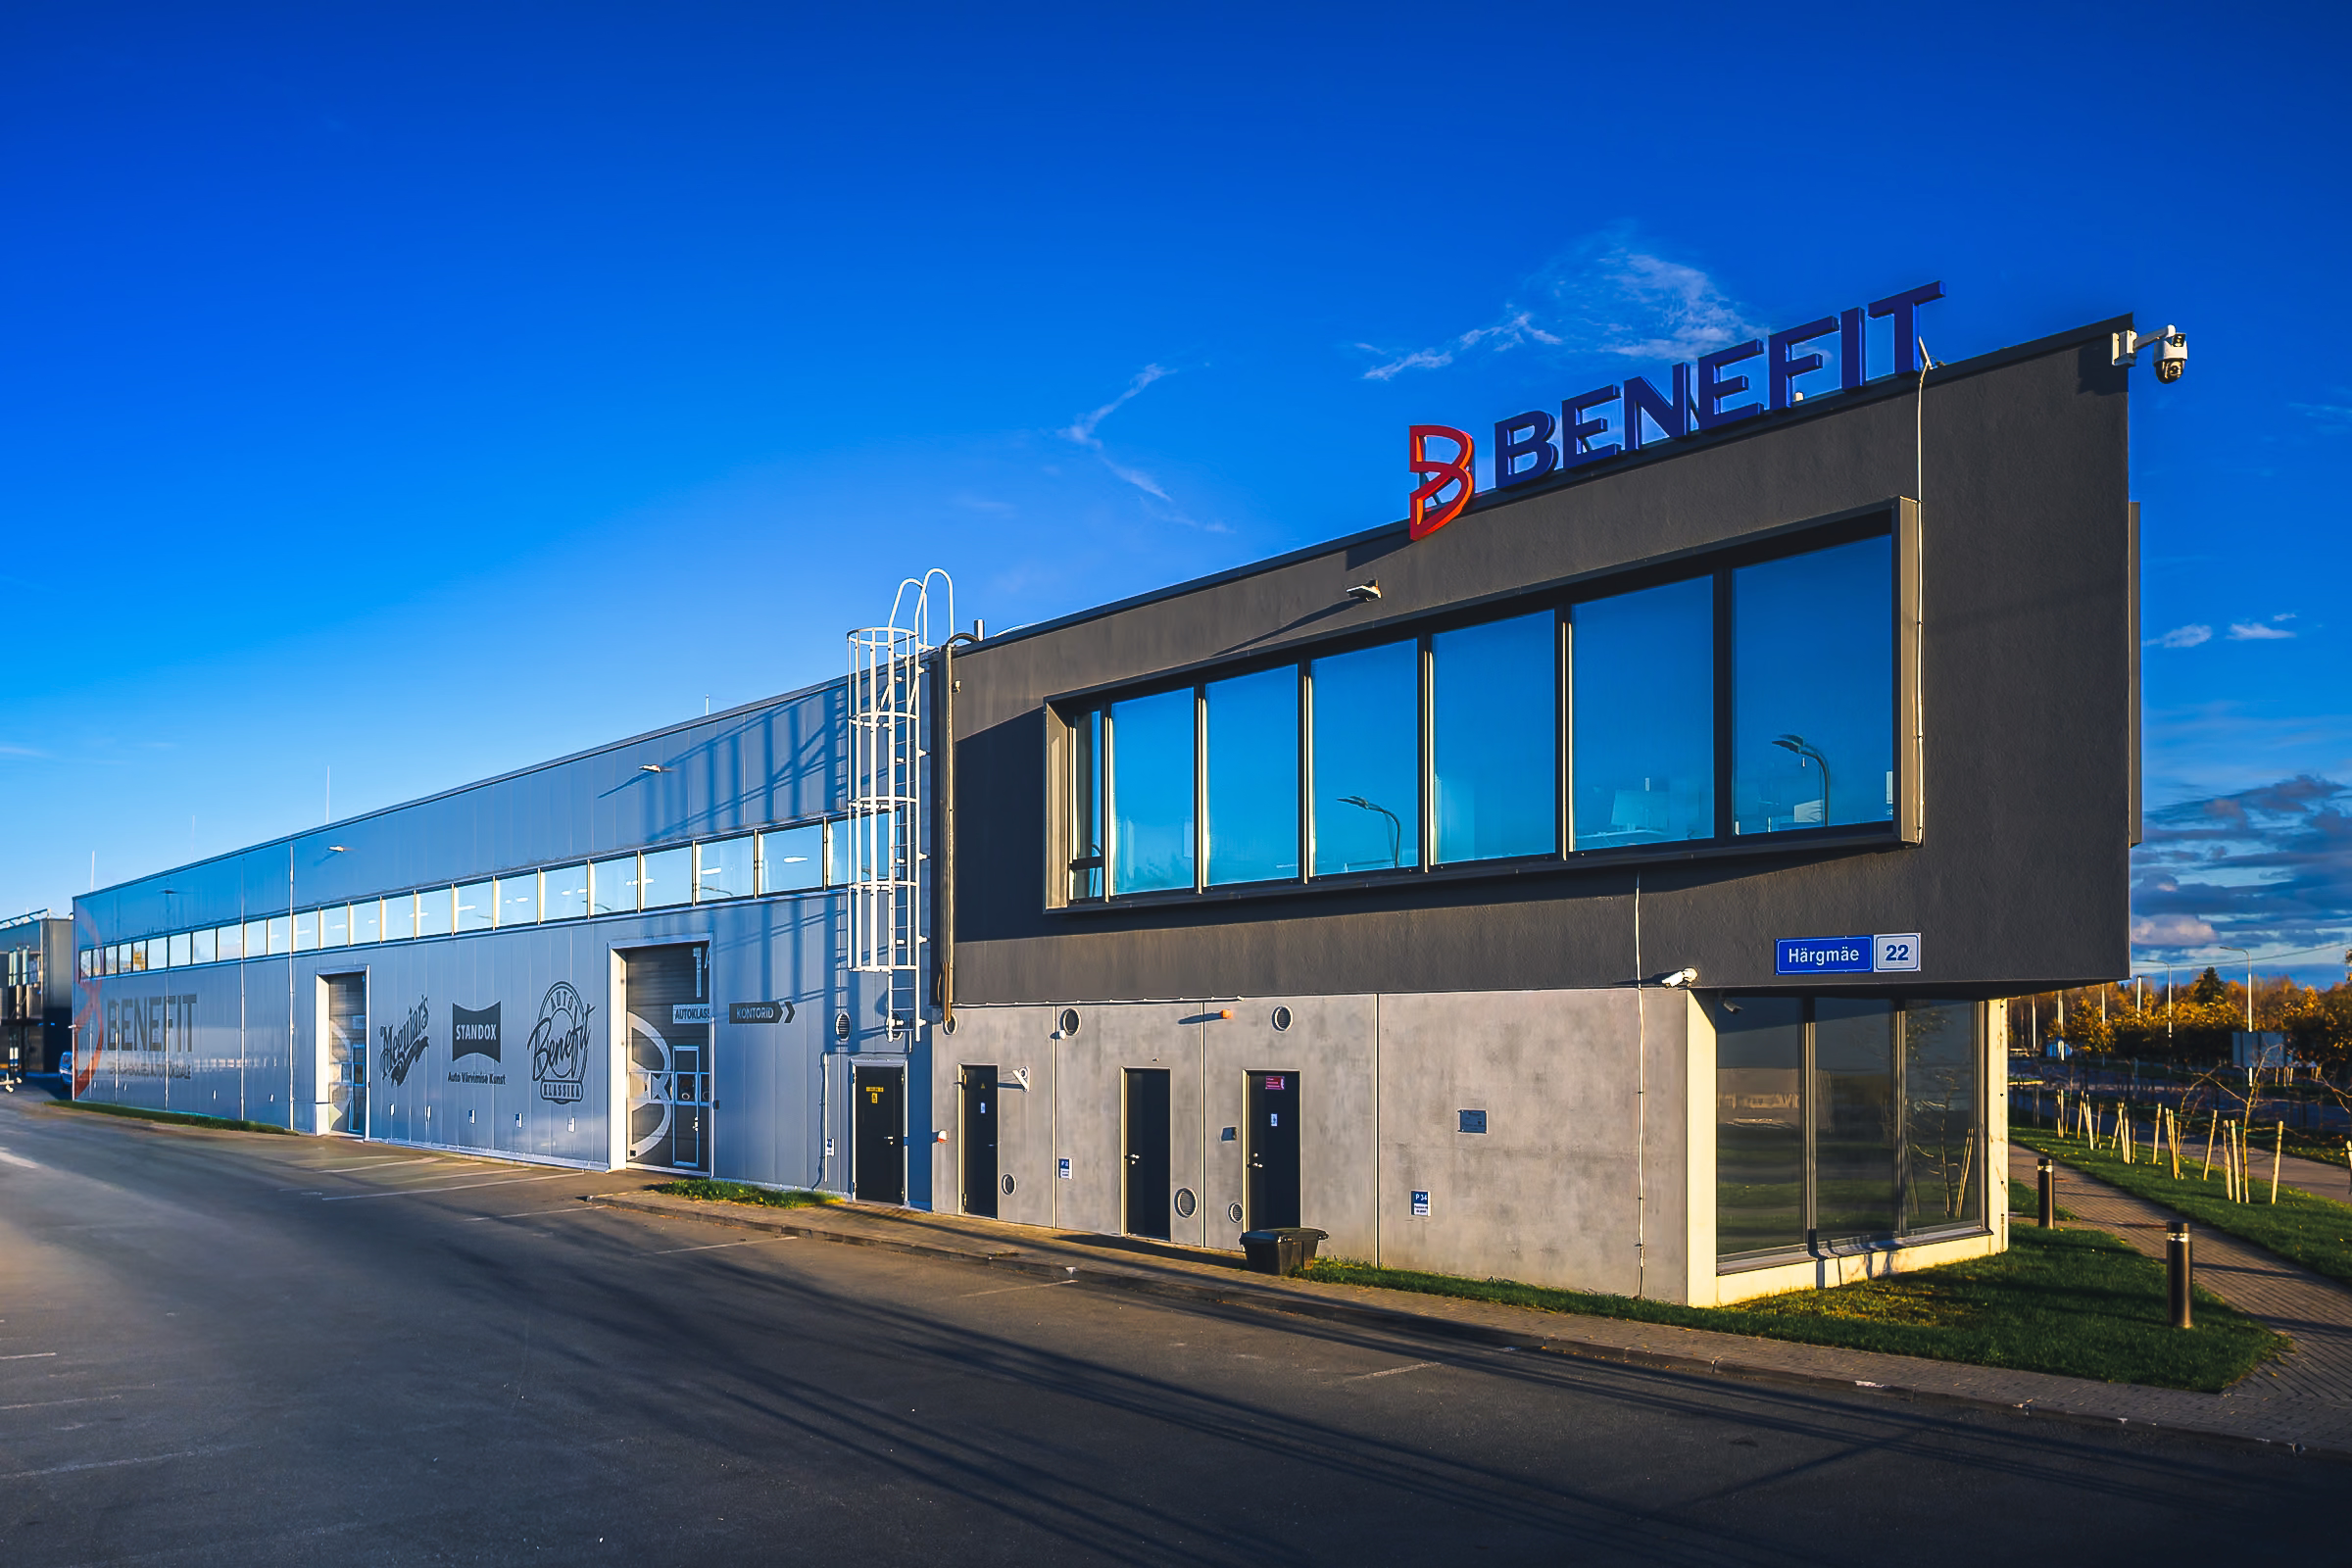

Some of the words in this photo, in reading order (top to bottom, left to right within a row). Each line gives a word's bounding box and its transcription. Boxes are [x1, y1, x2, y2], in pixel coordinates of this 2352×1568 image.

[1494, 280, 1946, 490] BENEFIT
[1788, 946, 1860, 966] Härgmäe
[1885, 944, 1909, 961] 22
[551, 990, 574, 1012] AUTO
[107, 993, 197, 1053] BENEFIT
[736, 1006, 774, 1020] KONTORID
[456, 1024, 497, 1041] STANDOX
[526, 1003, 596, 1082] Benefit
[448, 1072, 462, 1083] Auto
[489, 1074, 507, 1086] Kunst
[543, 1083, 581, 1099] KLASSIKA
